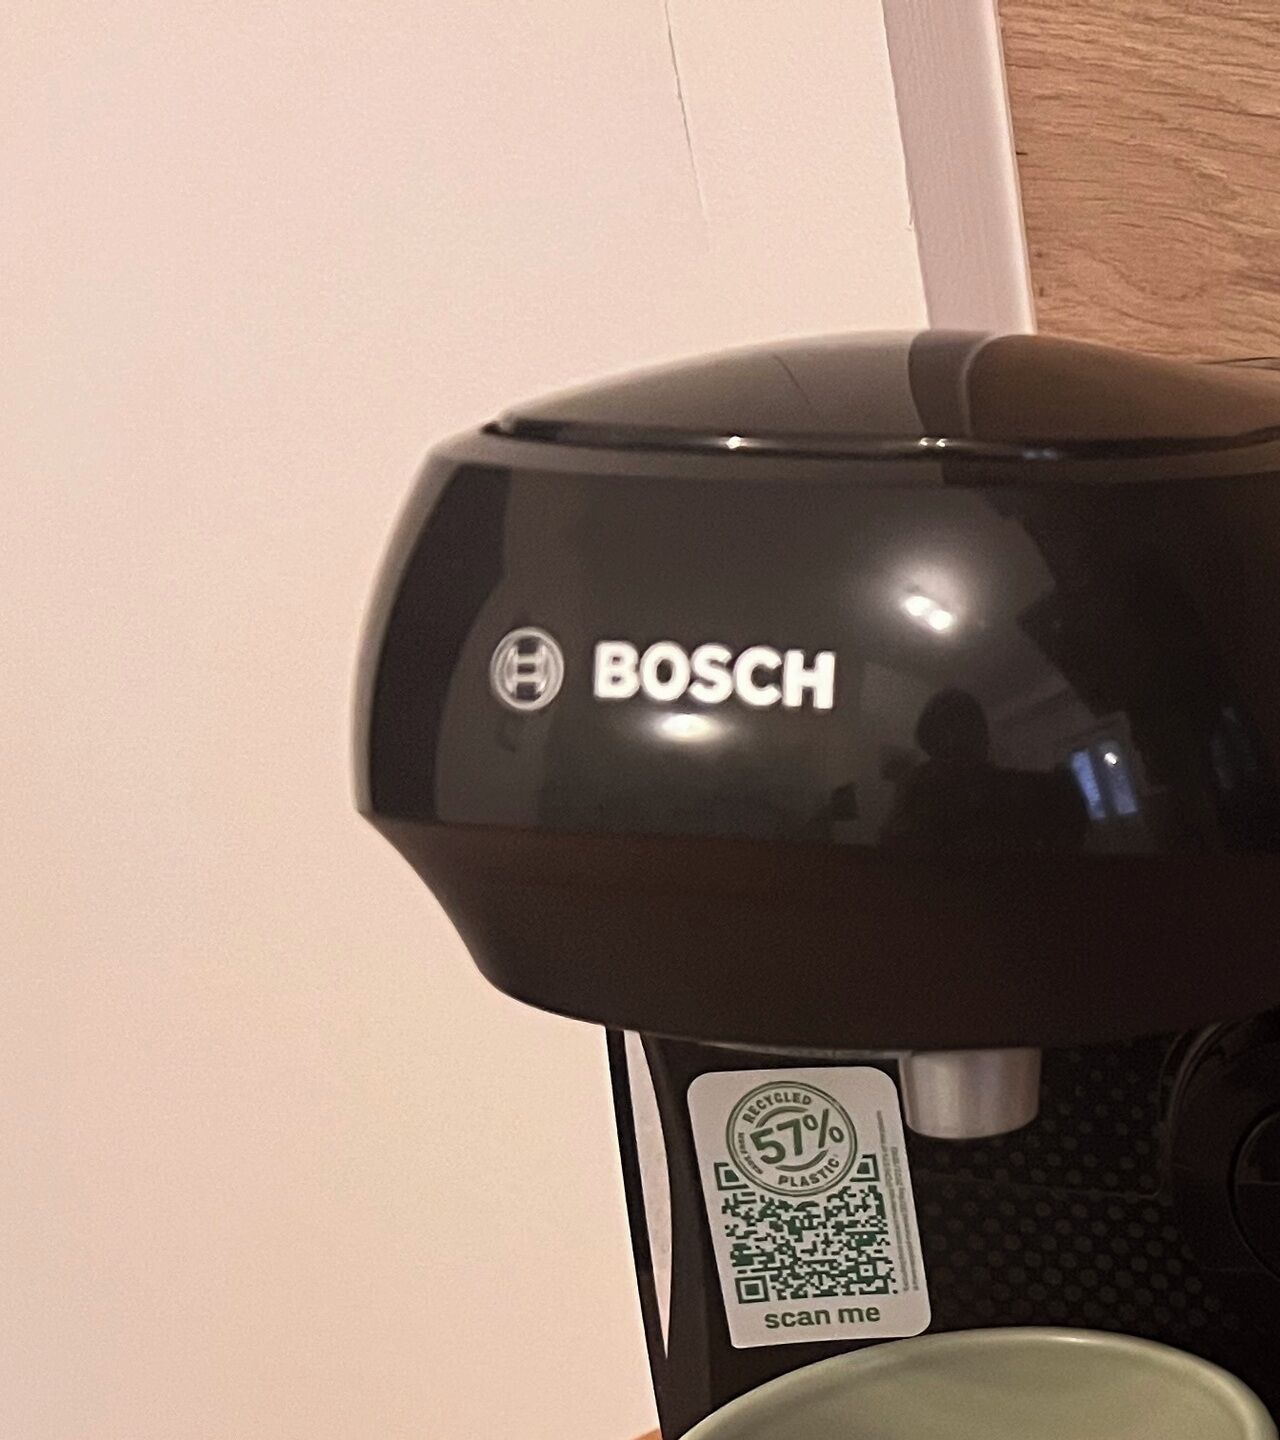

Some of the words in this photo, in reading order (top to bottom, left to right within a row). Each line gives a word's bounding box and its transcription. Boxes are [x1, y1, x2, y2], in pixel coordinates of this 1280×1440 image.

[594, 640, 837, 709] BOSCH
[742, 1092, 812, 1124] RECYCLED
[749, 1108, 845, 1165] 57%
[777, 1157, 841, 1187] PLASTIC
[764, 1309, 831, 1329] scan
[838, 1306, 881, 1324] me
